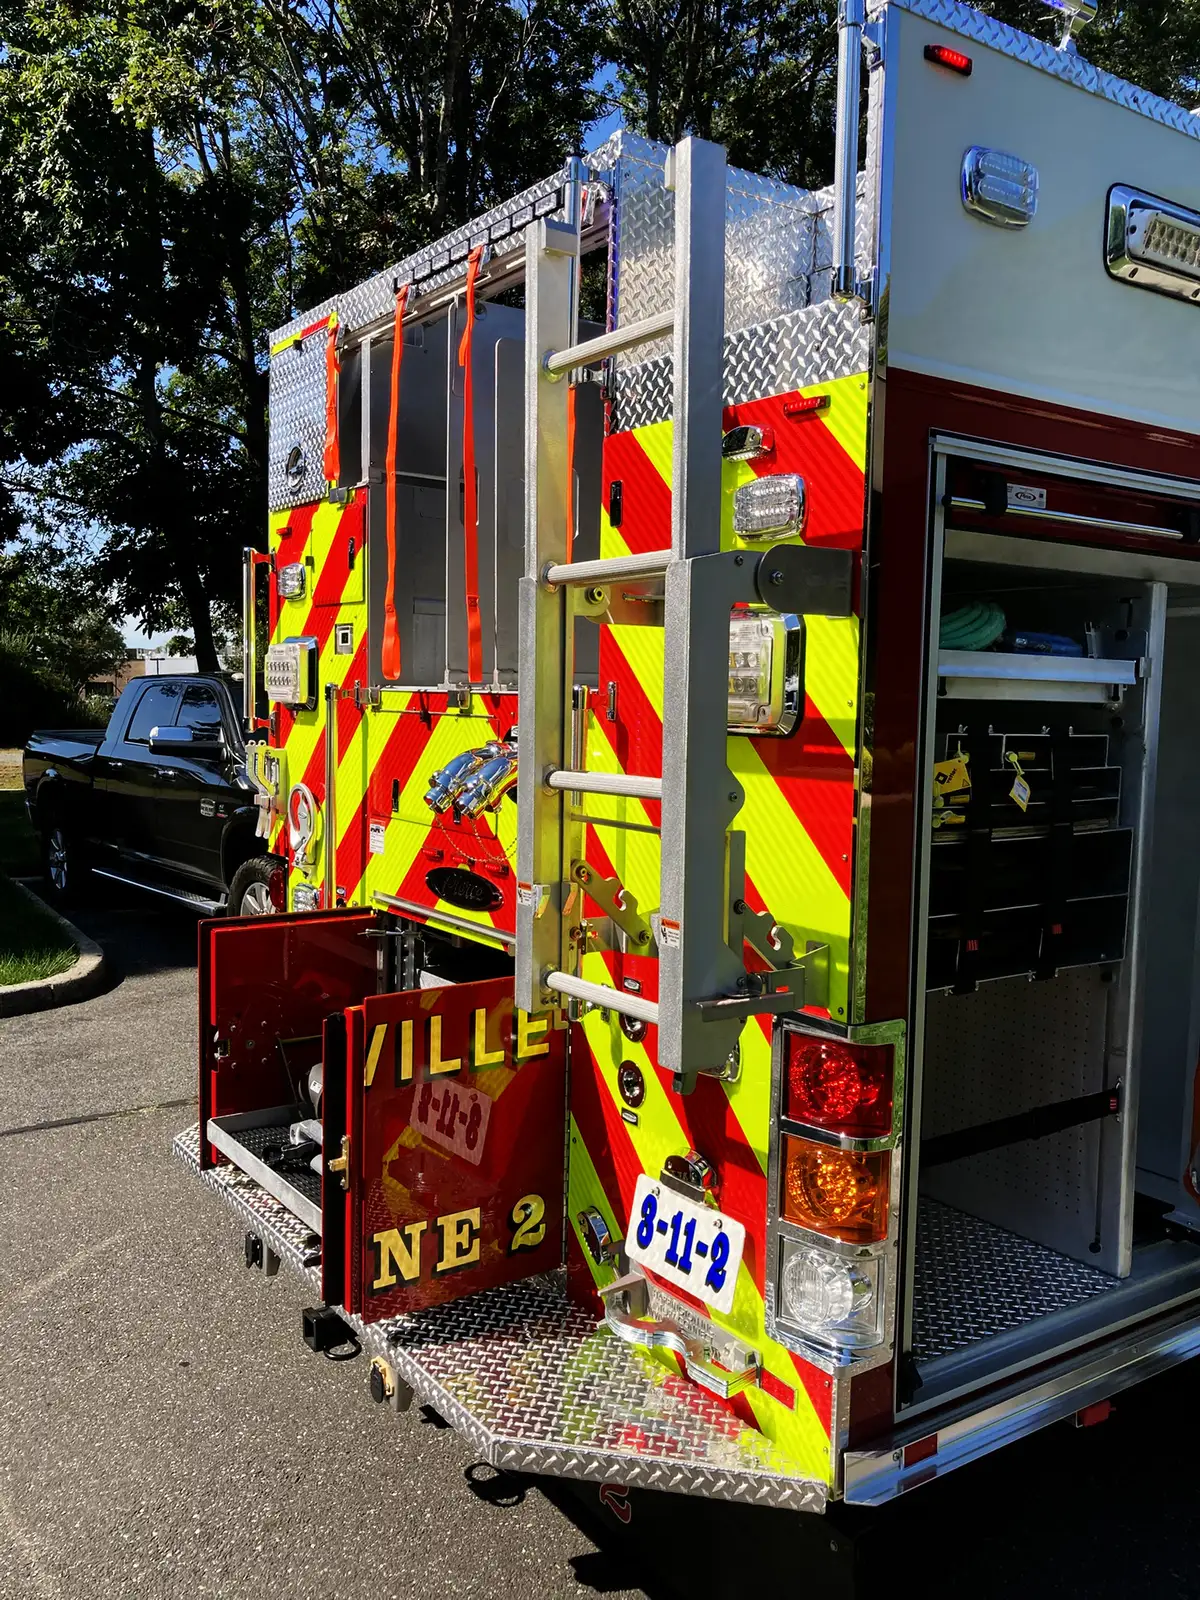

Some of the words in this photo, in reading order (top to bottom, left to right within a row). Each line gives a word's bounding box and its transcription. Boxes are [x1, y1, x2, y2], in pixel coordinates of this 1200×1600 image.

[373, 1207, 481, 1290] NE
[511, 1193, 547, 1251] 2
[636, 1193, 730, 1294] 8-11-2
